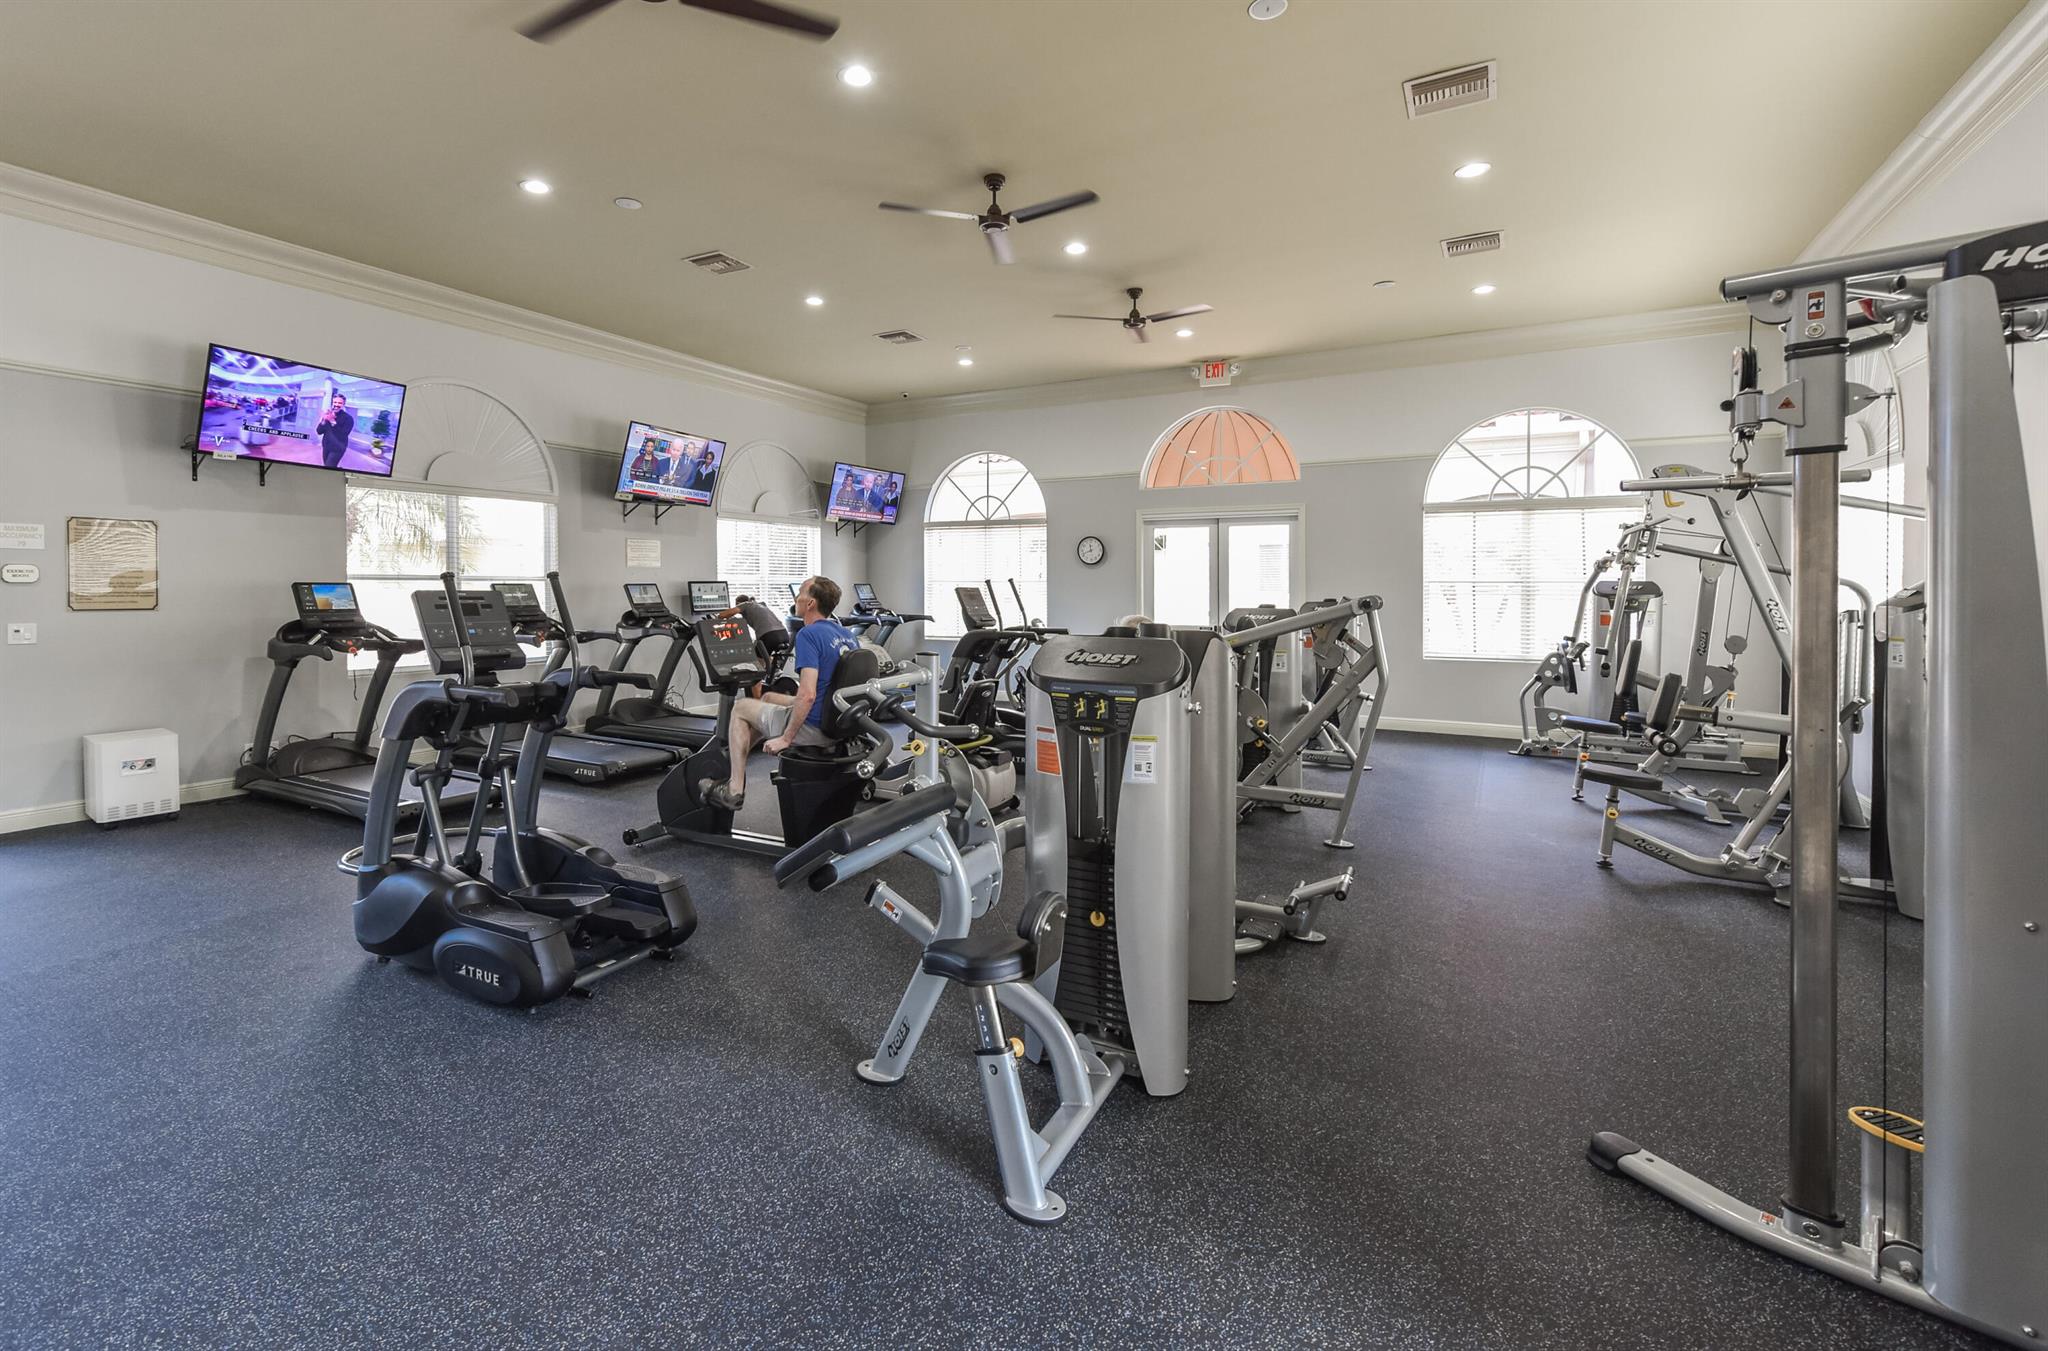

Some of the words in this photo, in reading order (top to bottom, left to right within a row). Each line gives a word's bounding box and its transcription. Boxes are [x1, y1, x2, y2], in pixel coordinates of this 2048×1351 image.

[1205, 362, 1225, 379] EXIT
[281, 431, 305, 439] APPLAUSE
[1766, 598, 1788, 634] HOIST
[1068, 651, 1137, 664] HOIST
[580, 768, 596, 777] TRUE
[1289, 793, 1327, 807] HOIST
[1634, 838, 1675, 859] HOIST
[468, 965, 500, 986] TRUE
[887, 1017, 910, 1058] HOIST
